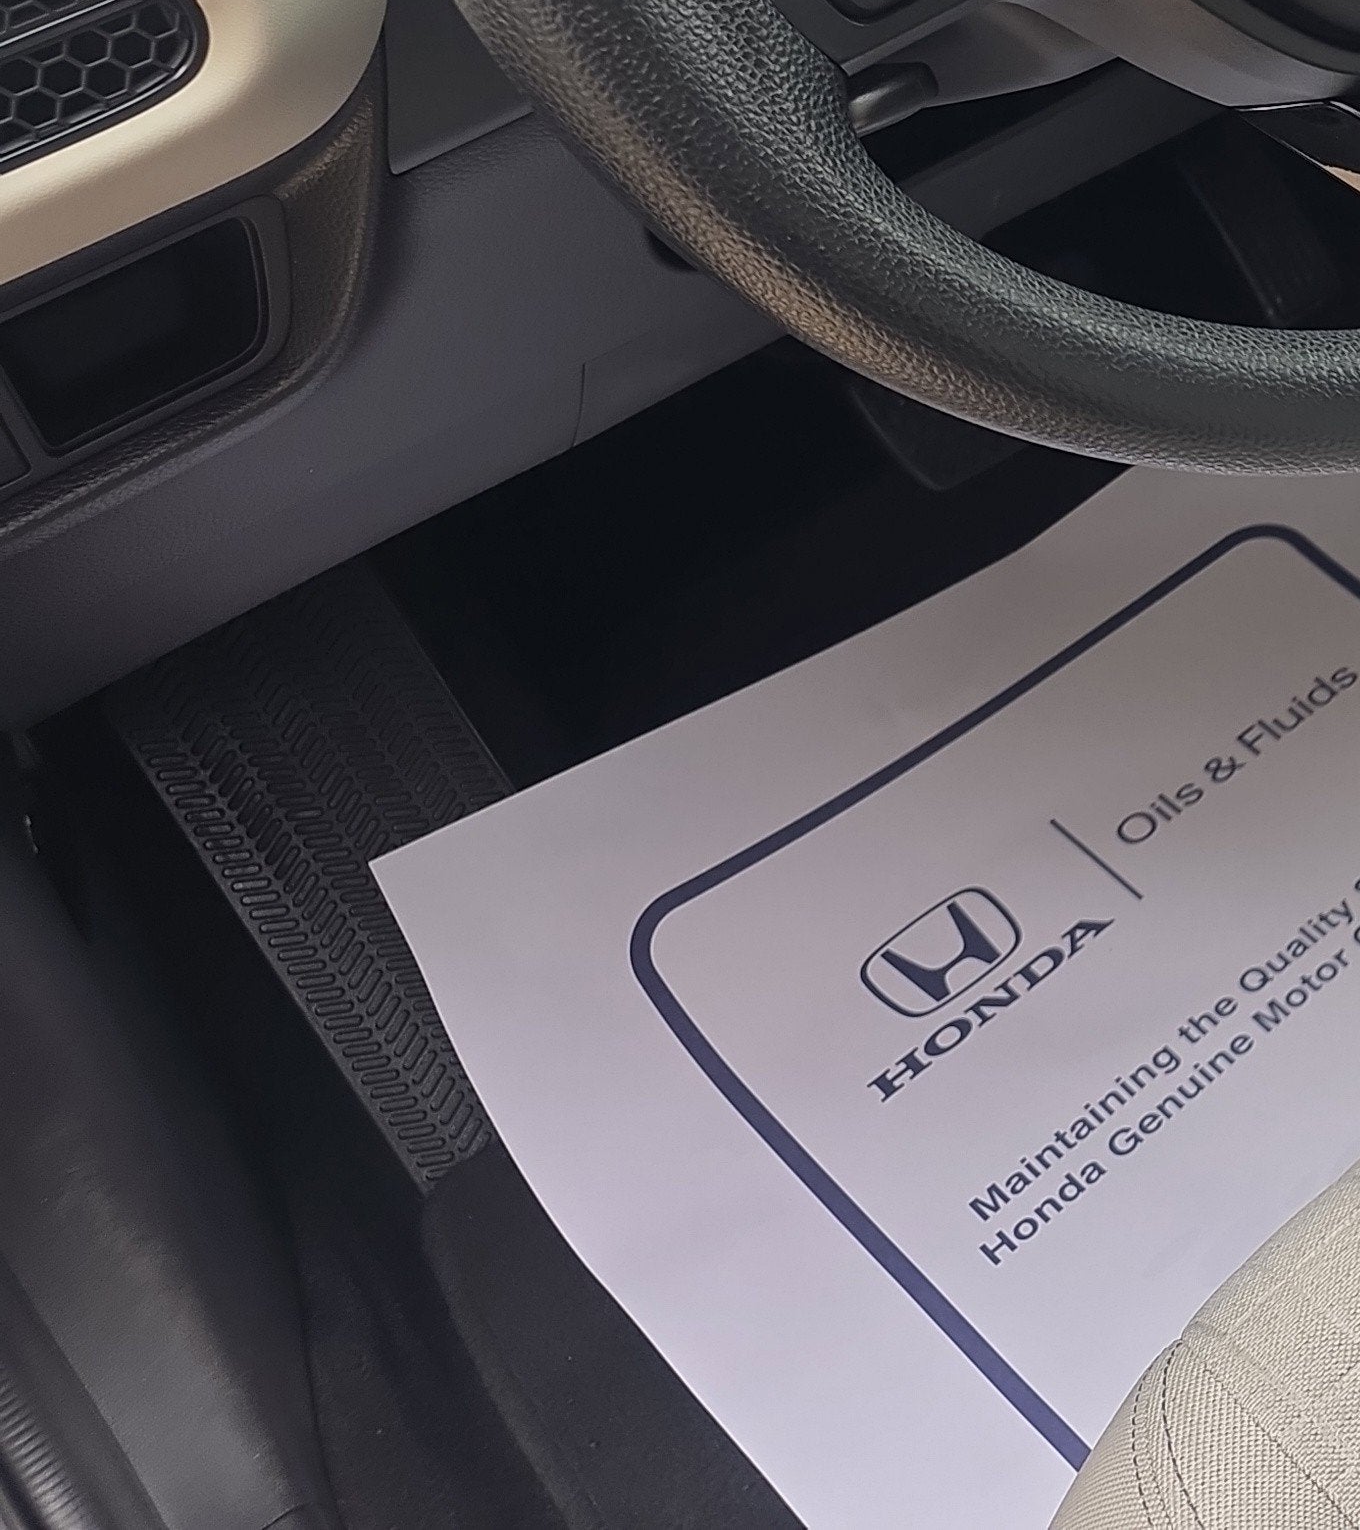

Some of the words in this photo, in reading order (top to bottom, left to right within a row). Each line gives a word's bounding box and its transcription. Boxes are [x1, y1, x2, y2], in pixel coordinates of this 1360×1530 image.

[1115, 780, 1206, 847] Oils
[1203, 755, 1246, 786] &
[1236, 663, 1360, 760] Fluids
[867, 916, 1116, 1103] HONDA
[968, 1044, 1183, 1222] Maintaining
[1177, 992, 1240, 1045] the
[1238, 900, 1356, 994] Quality
[978, 1158, 1109, 1268] Honda
[1107, 1030, 1256, 1158] Genuine
[1252, 948, 1352, 1034] Motor
